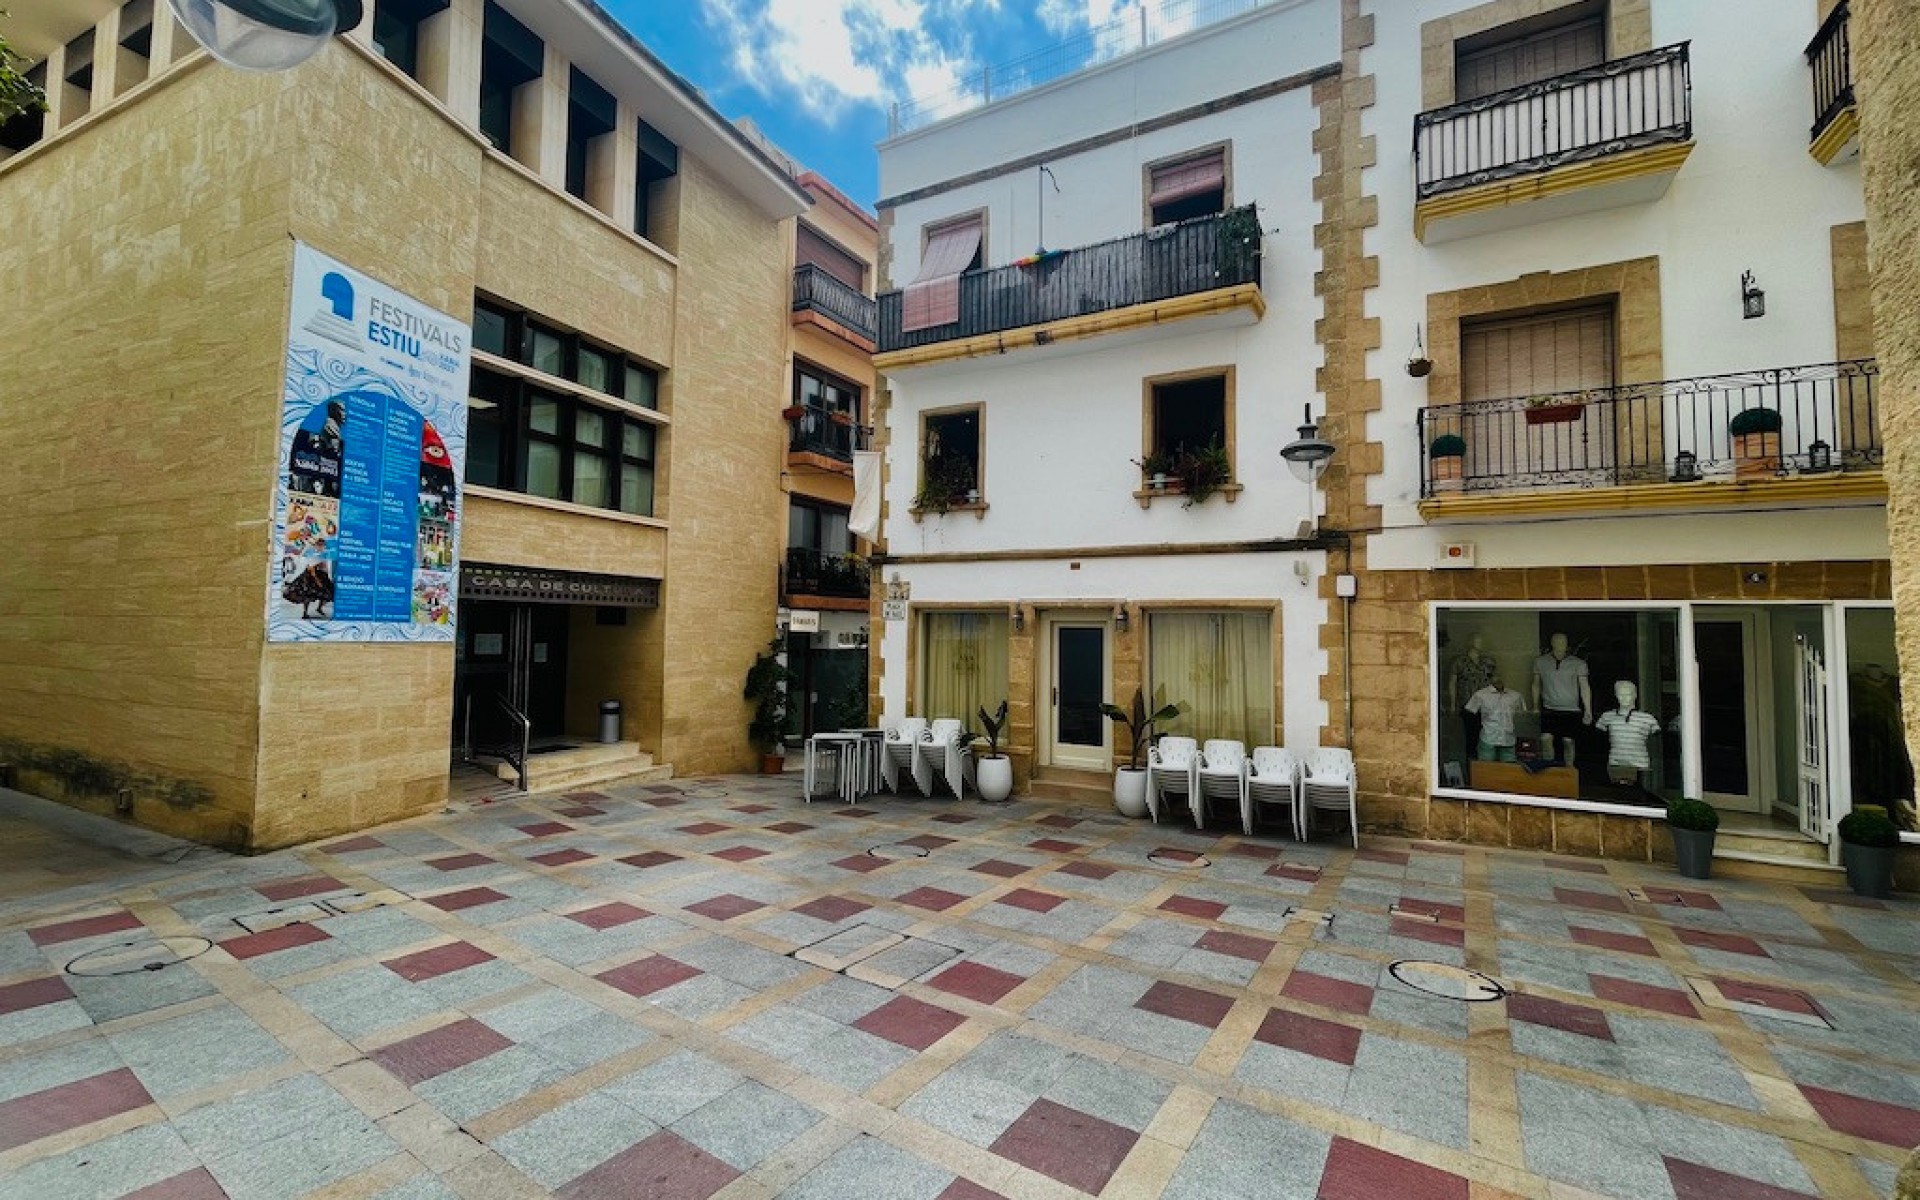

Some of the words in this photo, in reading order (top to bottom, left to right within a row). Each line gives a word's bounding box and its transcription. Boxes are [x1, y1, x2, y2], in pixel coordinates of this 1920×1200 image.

[368, 321, 421, 358] ESTIU
[370, 297, 462, 353] FESTIVALS
[472, 576, 533, 590] CASA
[540, 581, 563, 592] DE
